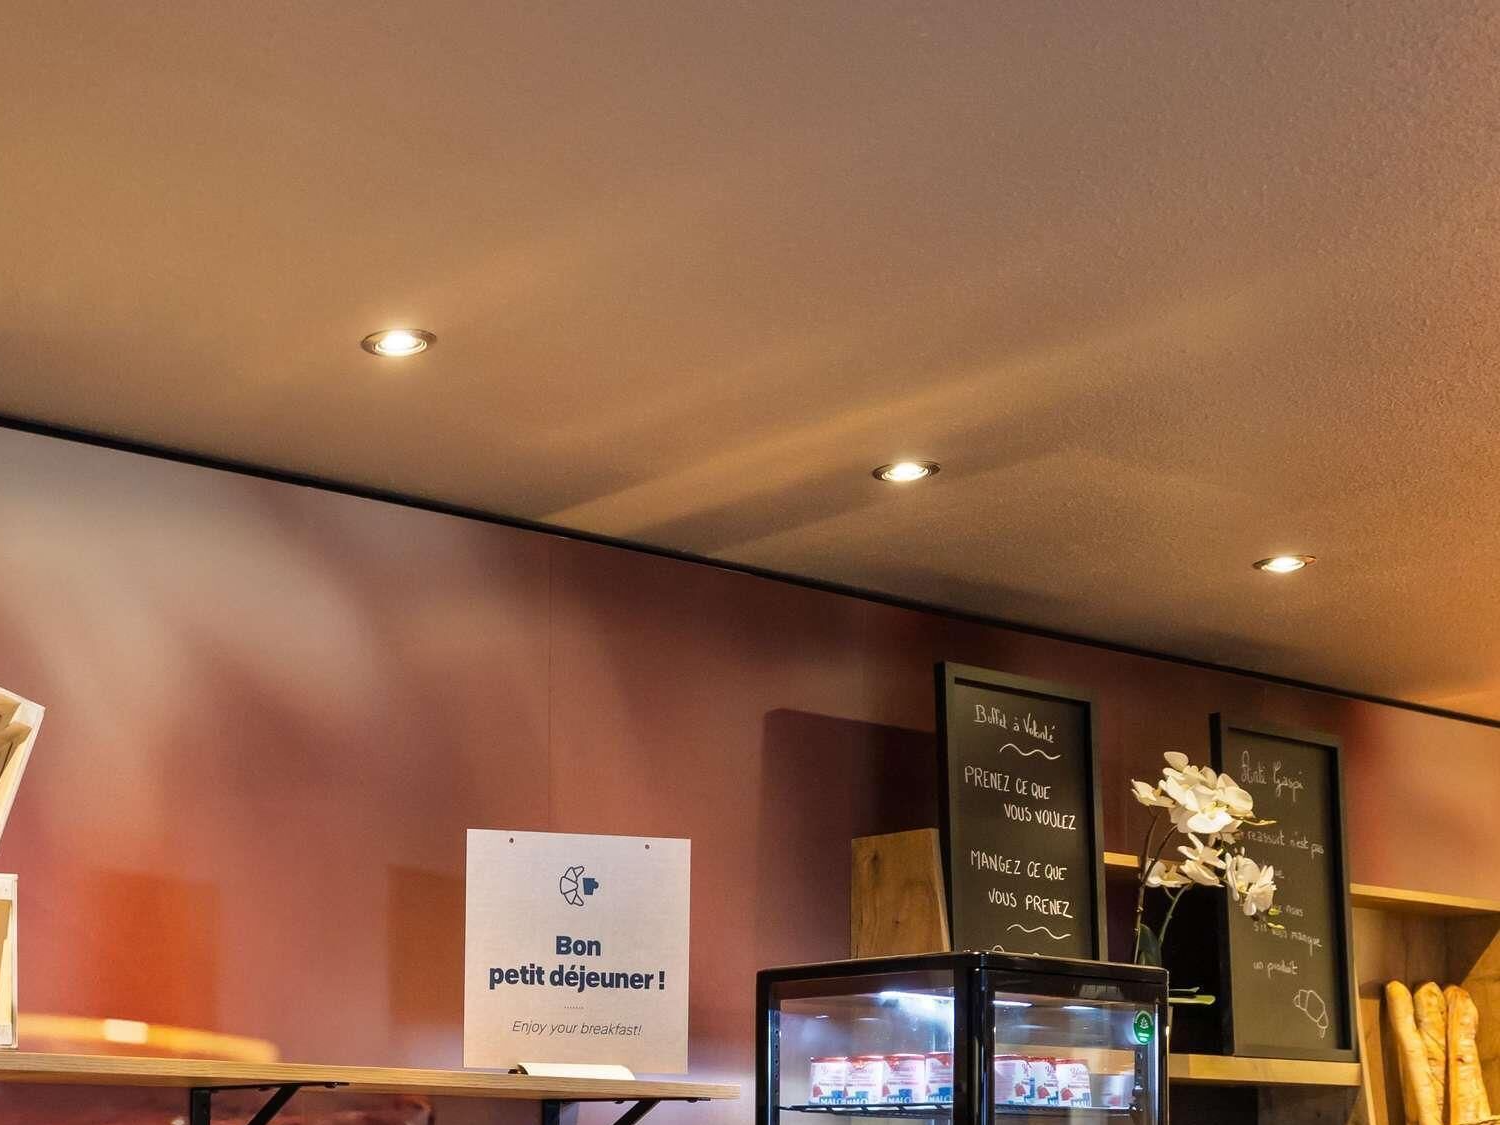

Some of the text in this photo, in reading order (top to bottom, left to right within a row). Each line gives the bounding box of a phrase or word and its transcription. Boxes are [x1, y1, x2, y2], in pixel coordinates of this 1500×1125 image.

[964, 765, 1052, 800] PRENEZ CE QUE
[1003, 803, 1077, 831] VOUS VOULEZ
[970, 849, 1068, 882] MANGEZ CE QUE
[988, 888, 1073, 919] VOUS PRENEZ
[556, 936, 602, 957] Bon
[489, 963, 545, 990] petit
[549, 964, 654, 993] déjeuner
[512, 1020, 642, 1037] Enjoy your breakfast!
